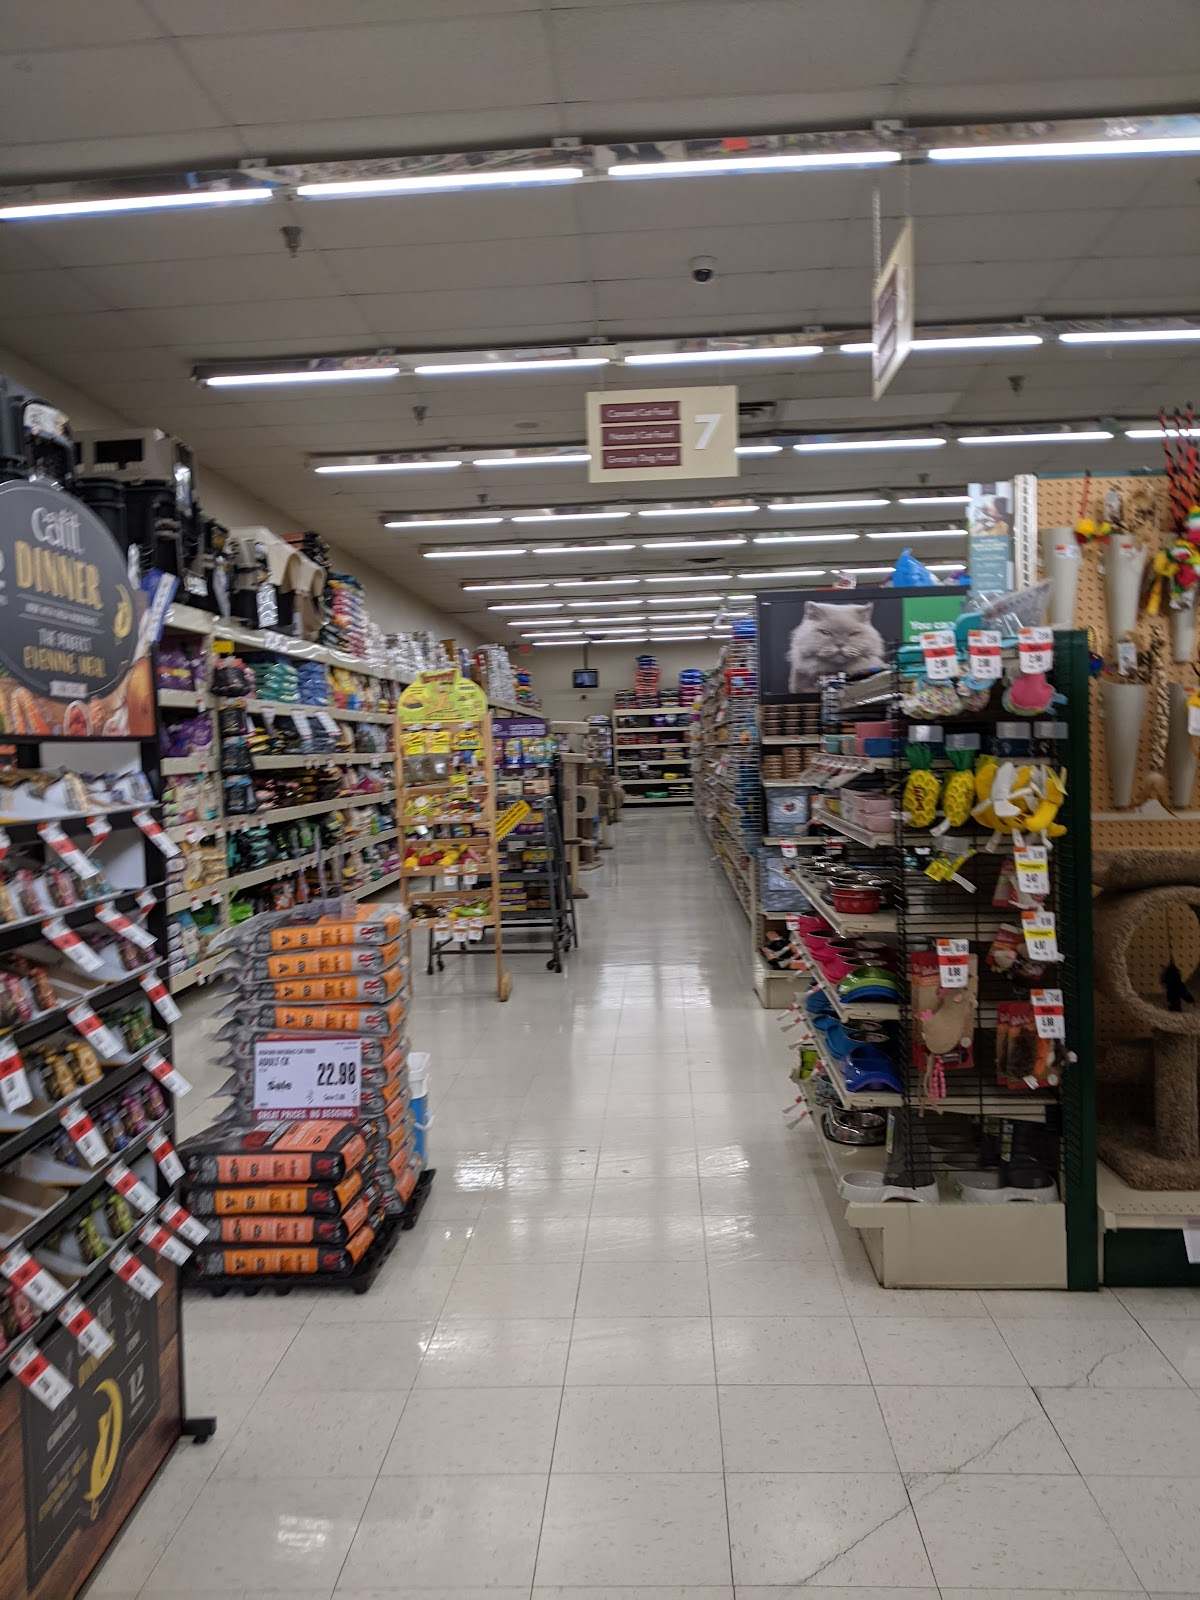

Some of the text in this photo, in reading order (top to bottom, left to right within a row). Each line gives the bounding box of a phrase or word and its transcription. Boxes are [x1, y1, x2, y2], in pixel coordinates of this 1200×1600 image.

[694, 413, 721, 450] 7
[15, 540, 103, 610] DINNER
[317, 1061, 357, 1086] 22.98
